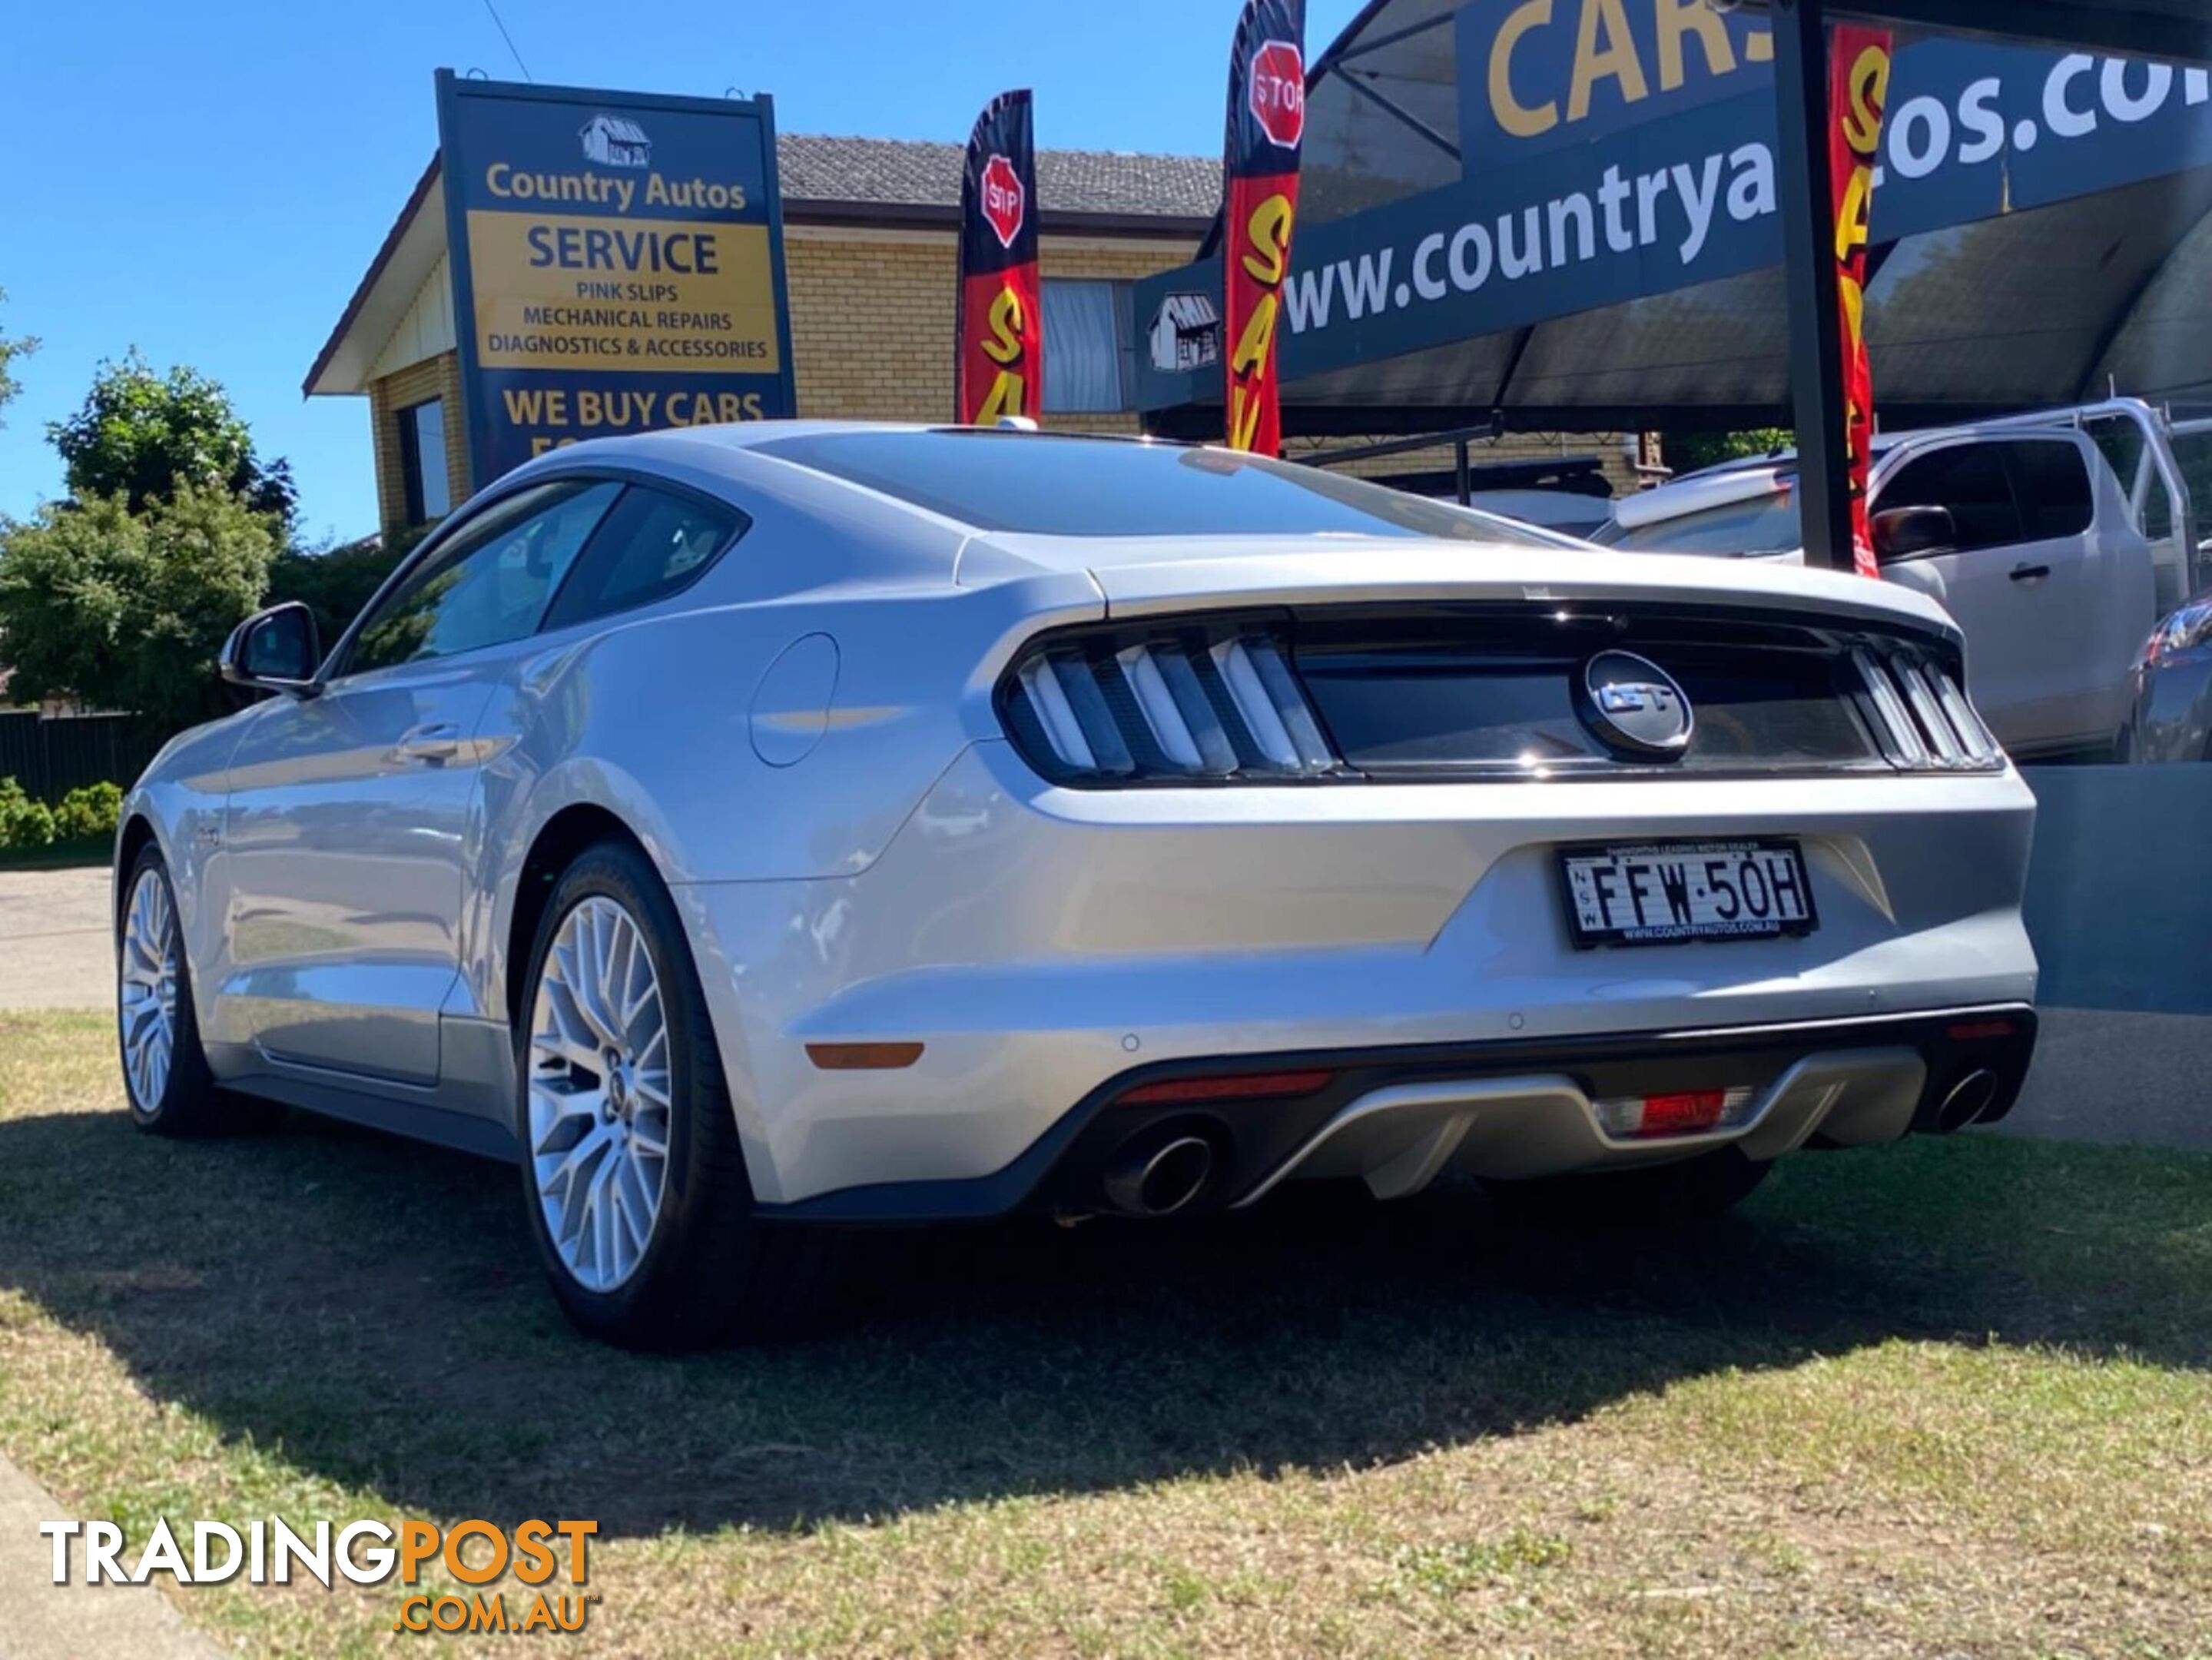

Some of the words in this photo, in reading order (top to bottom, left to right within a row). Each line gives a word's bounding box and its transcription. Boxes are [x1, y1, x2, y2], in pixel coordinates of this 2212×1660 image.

[1488, 0, 1774, 137] CAR
[486, 163, 635, 211] Country
[646, 173, 746, 209] Autos
[527, 225, 719, 274] SERVICE
[577, 281, 622, 300] PINK
[628, 284, 678, 302] SLIPS
[523, 307, 652, 328] MECHANICAL
[657, 312, 732, 330] REPAIRS
[488, 334, 622, 356] DIAGNOSTICS
[627, 338, 642, 356] &
[645, 339, 768, 358] ACCESSORIES
[503, 390, 569, 426] WE
[578, 390, 656, 427] BUY
[665, 392, 764, 427] CARS
